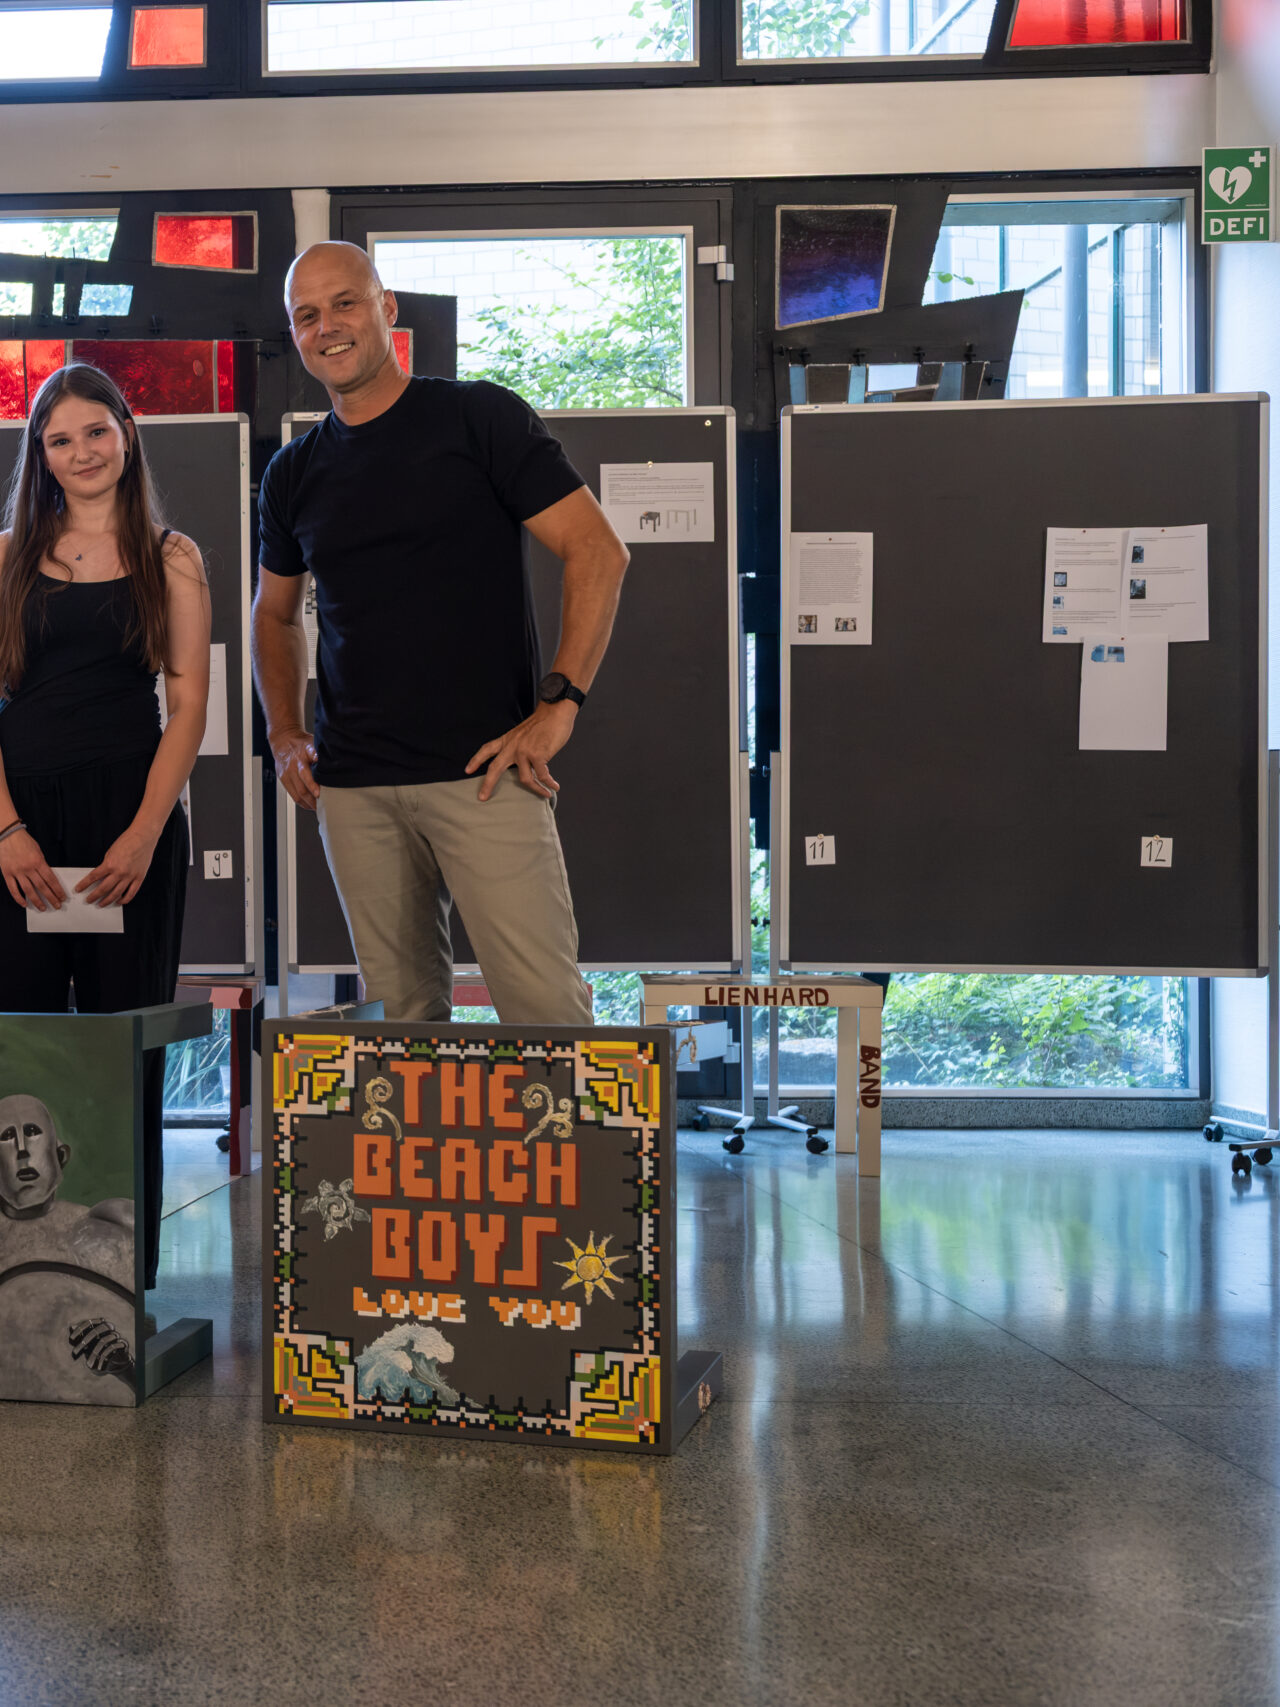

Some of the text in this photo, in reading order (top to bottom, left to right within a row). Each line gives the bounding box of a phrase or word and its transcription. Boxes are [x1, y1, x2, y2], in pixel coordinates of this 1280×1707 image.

[1210, 217, 1264, 236] DEFI
[810, 841, 825, 859] 11
[1145, 839, 1166, 862] 12
[704, 986, 829, 1006] LIENHARD
[390, 1061, 526, 1130] THE
[859, 1044, 881, 1109] BAND
[353, 1133, 579, 1208] BEACH
[371, 1207, 560, 1288] BOYS
